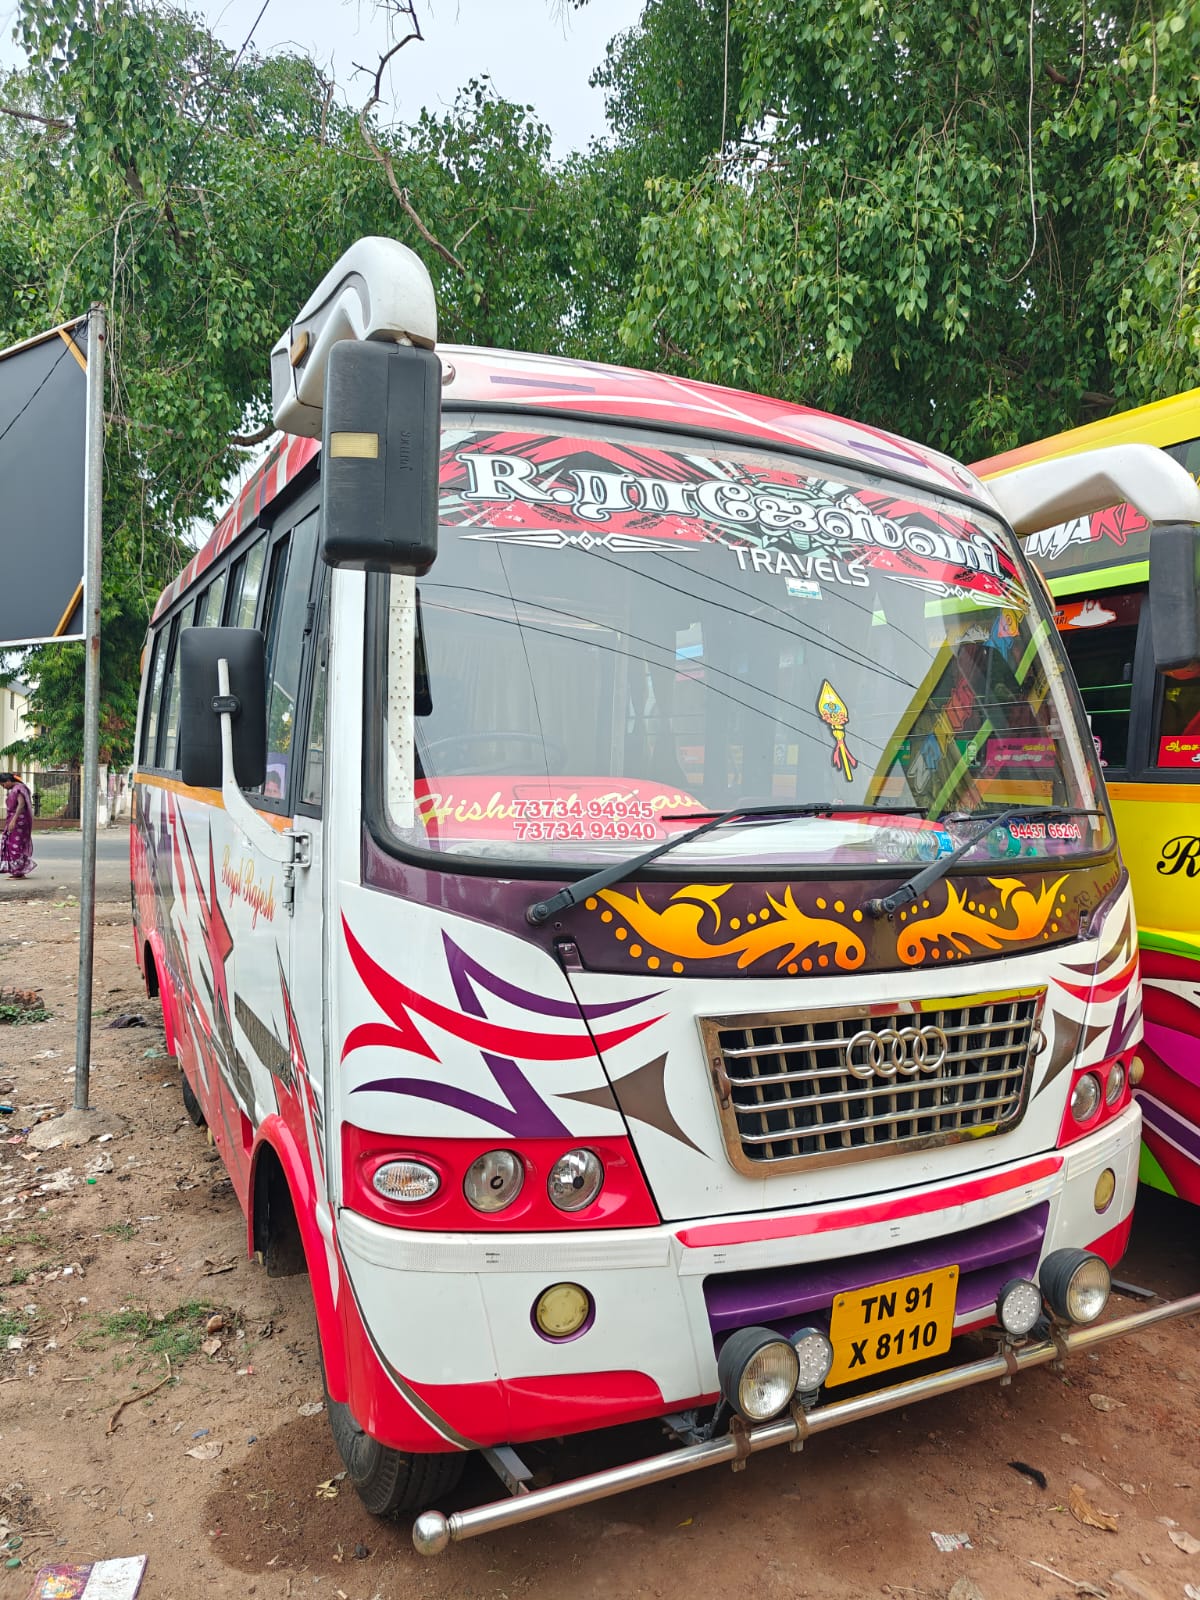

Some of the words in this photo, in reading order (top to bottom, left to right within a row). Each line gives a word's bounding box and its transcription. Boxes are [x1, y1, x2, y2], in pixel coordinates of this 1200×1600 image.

[728, 545, 870, 588] TRAVELS
[512, 799, 583, 819] 73734
[587, 800, 654, 819] 94945
[513, 820, 585, 841] 73734
[589, 820, 656, 841] 94940
[1009, 823, 1046, 839] 94437
[1048, 823, 1082, 839] 66201
[861, 1292, 897, 1324] TN
[905, 1283, 933, 1313] 91
[848, 1339, 868, 1369] X
[876, 1321, 937, 1360] 8110
